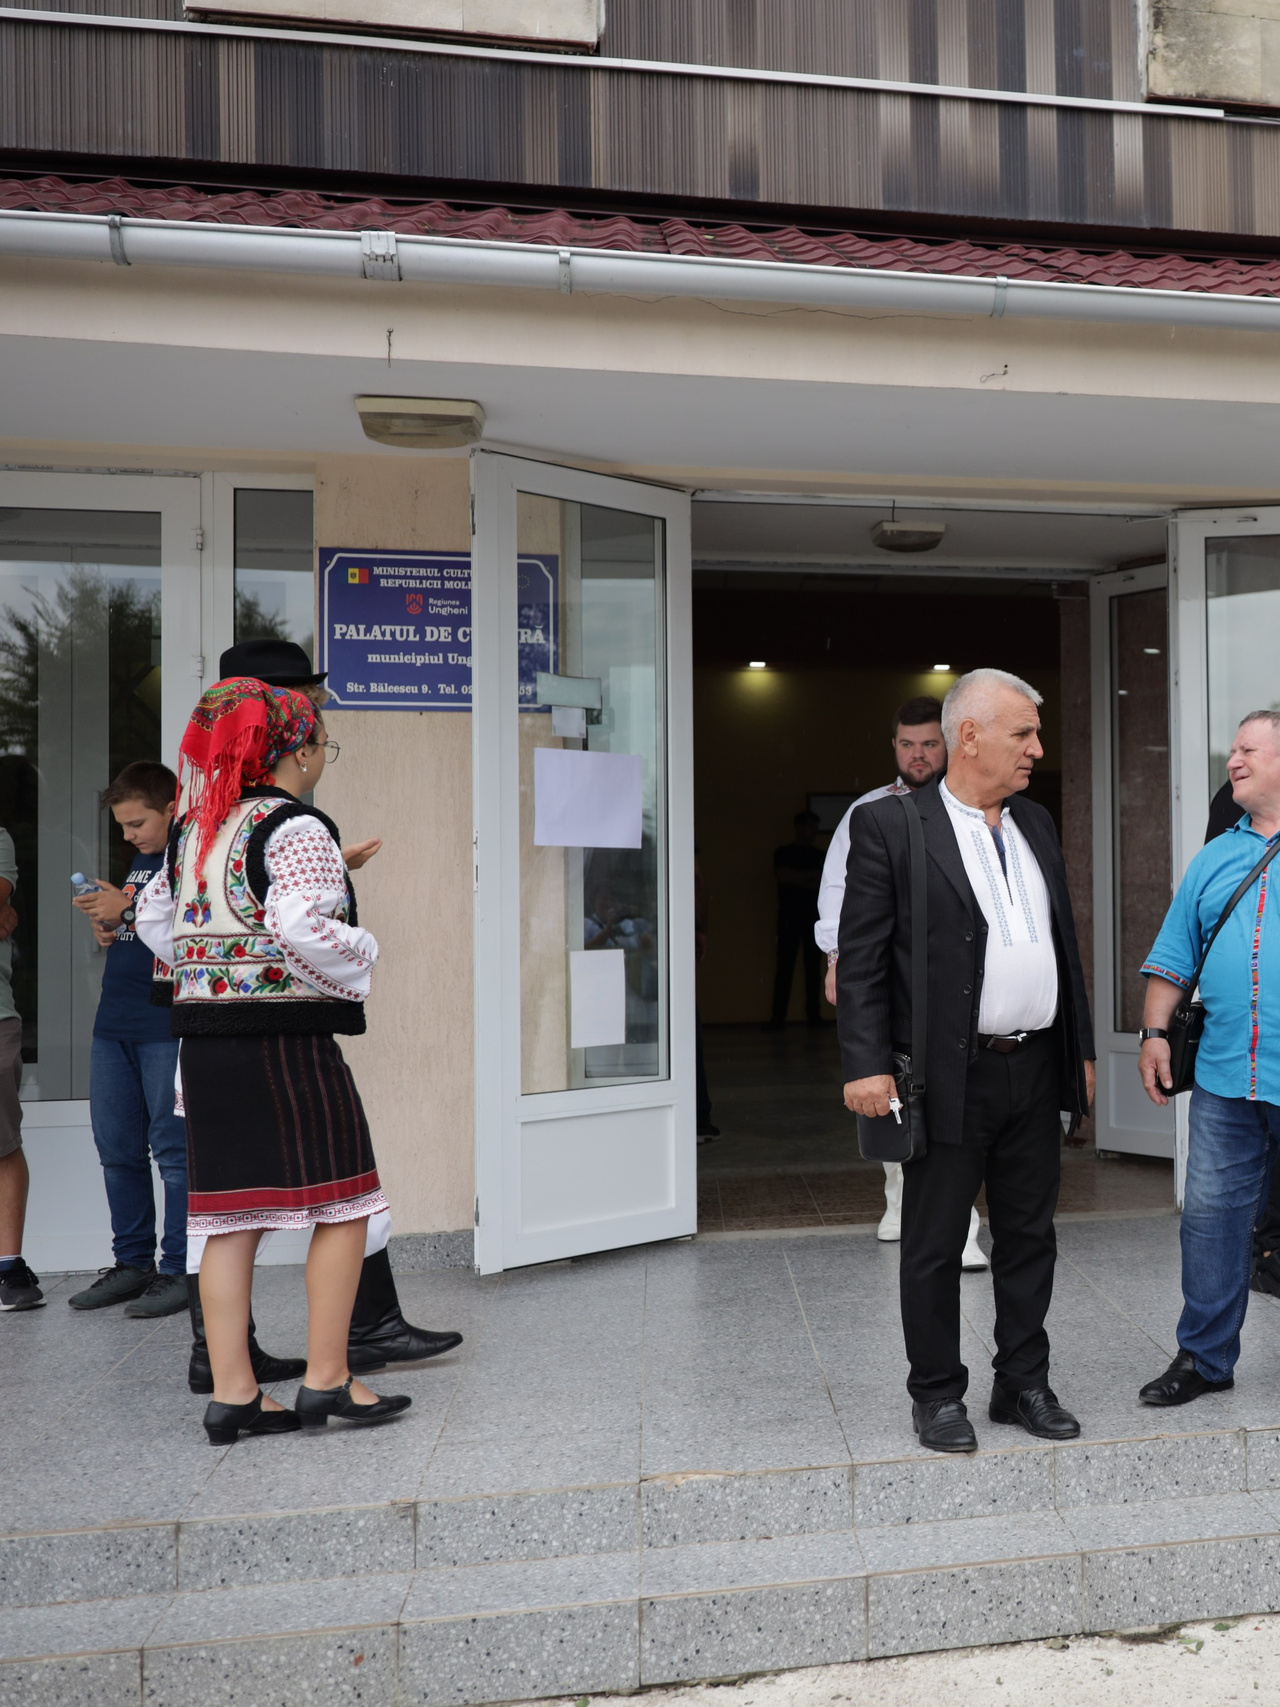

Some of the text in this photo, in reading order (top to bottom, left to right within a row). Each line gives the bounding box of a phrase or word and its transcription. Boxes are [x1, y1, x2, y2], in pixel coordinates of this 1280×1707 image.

[373, 566, 472, 578] MINISTERUL CULT
[380, 579, 441, 589] REPUBLICII
[428, 598, 460, 607] Regiunea
[428, 605, 468, 616] Ungheni
[333, 624, 420, 641] PALATUL
[424, 626, 452, 642] DE
[367, 652, 444, 667] municipiul
[346, 682, 367, 693] Str.
[370, 682, 418, 694] Bălcescu
[437, 684, 458, 694] Tel.
[126, 870, 152, 883] GAME
